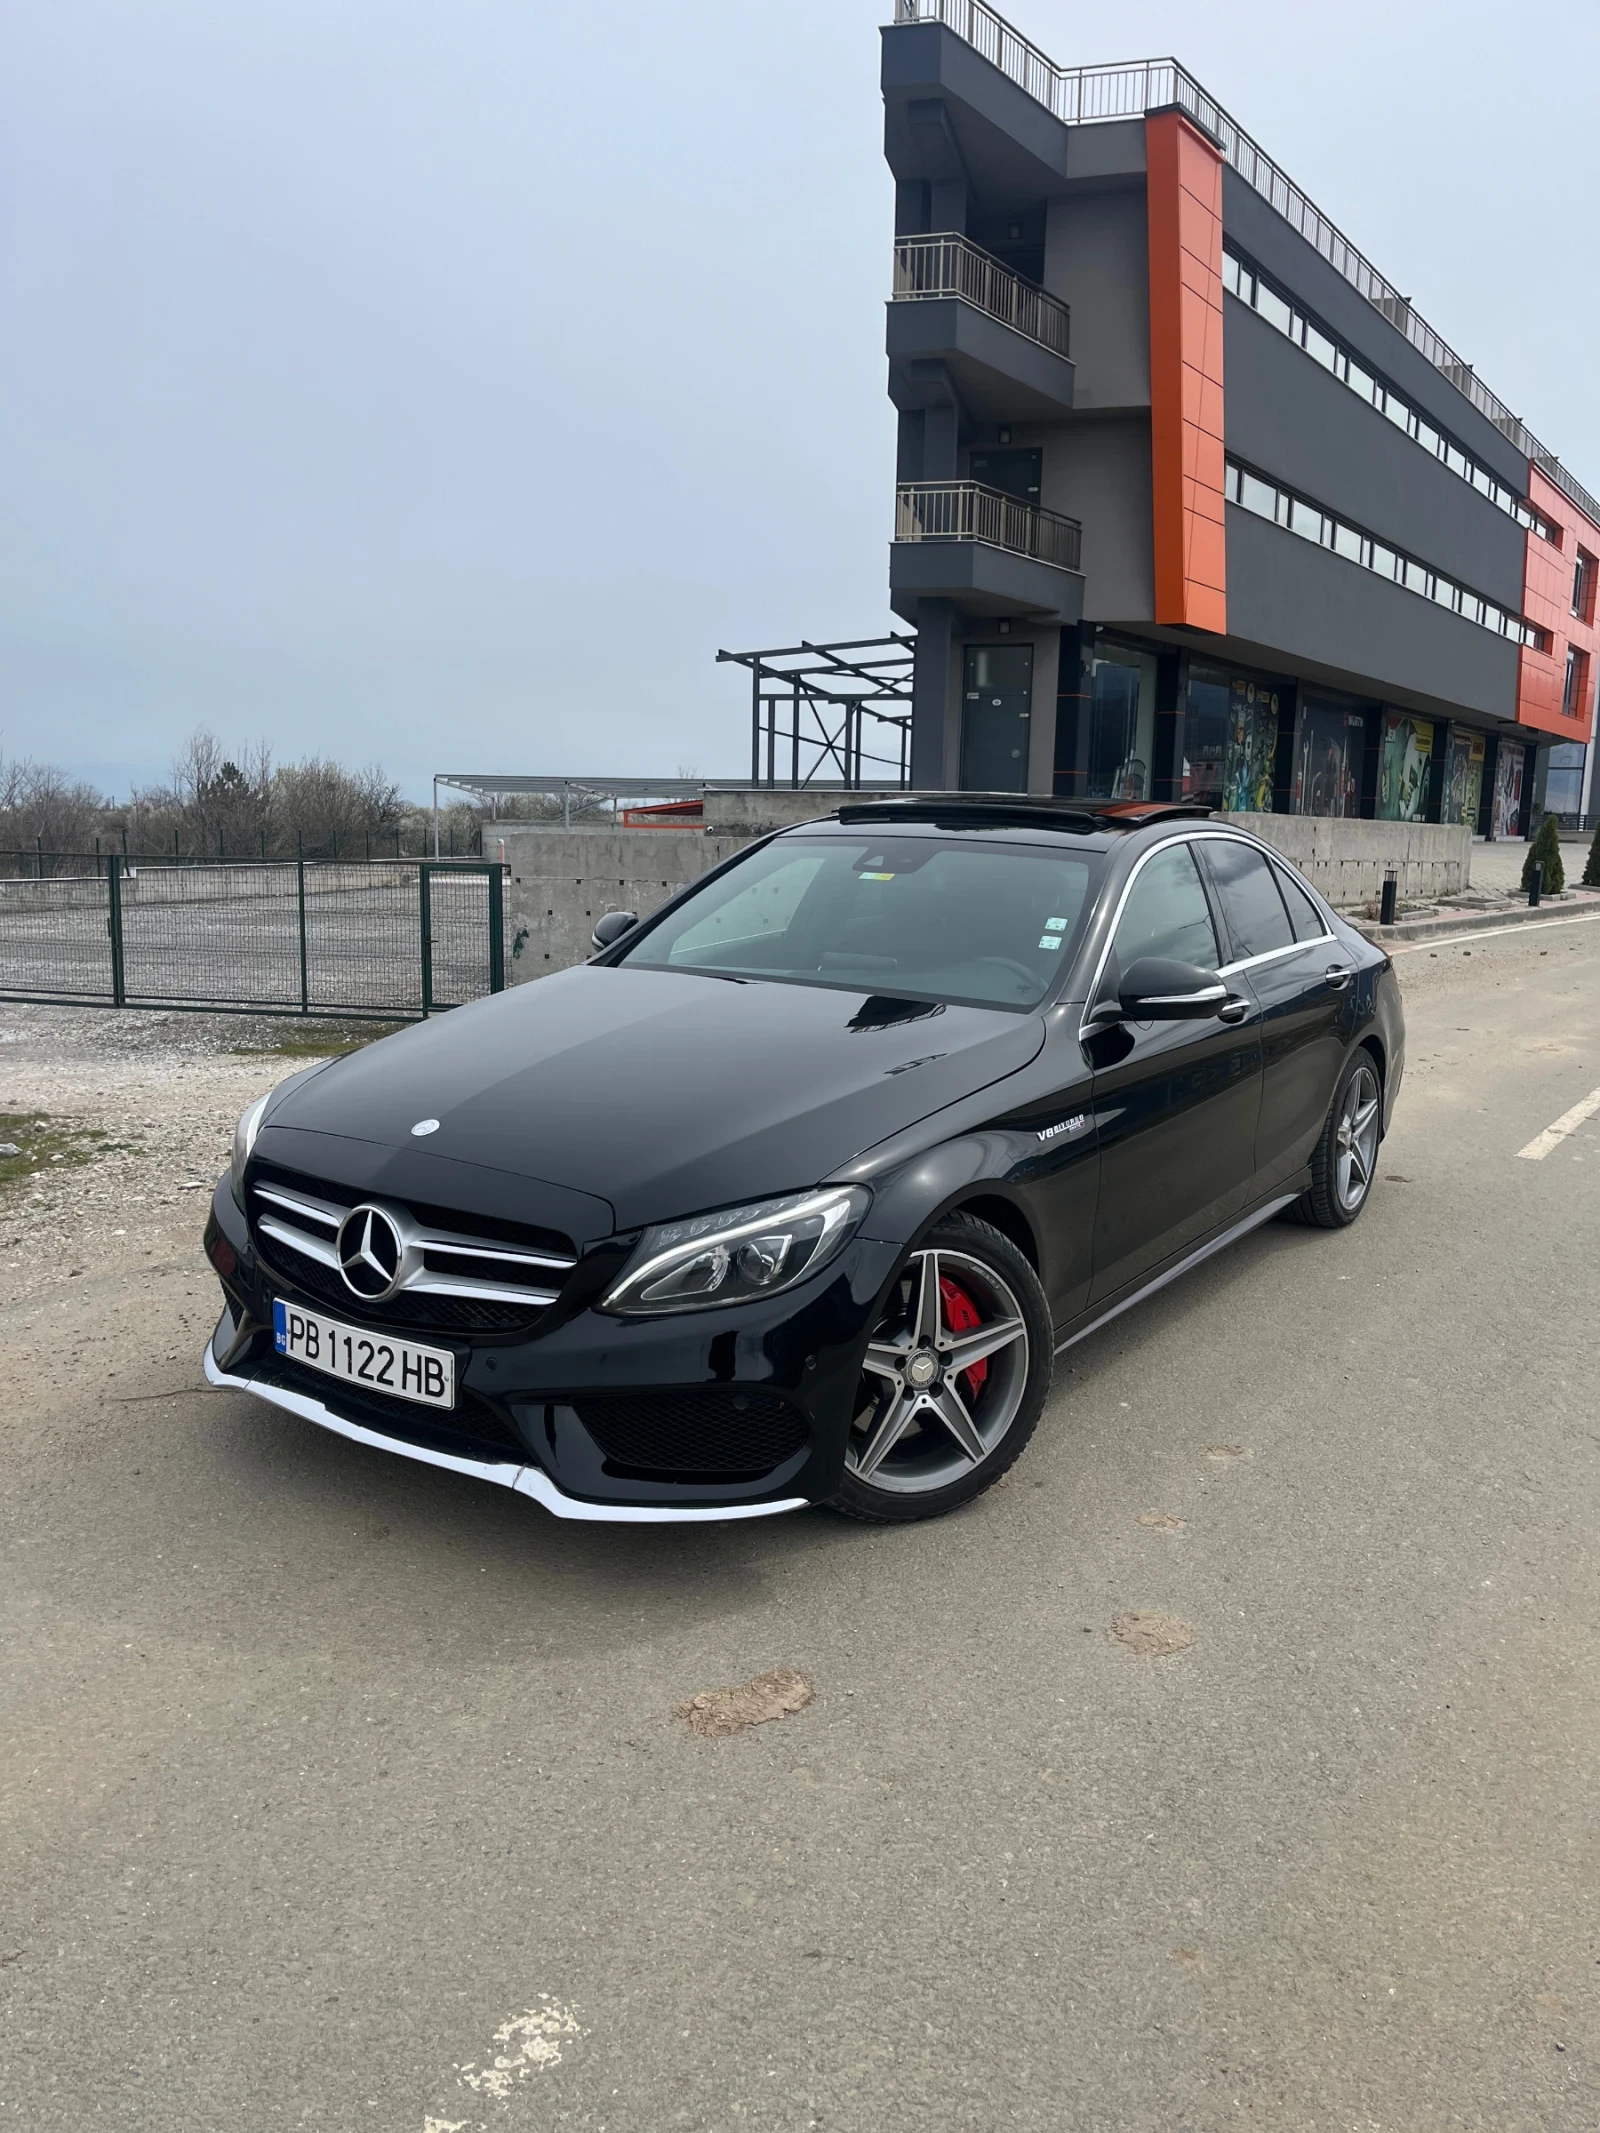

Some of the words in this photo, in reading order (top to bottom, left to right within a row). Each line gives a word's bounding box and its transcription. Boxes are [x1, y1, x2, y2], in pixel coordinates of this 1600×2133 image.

[1037, 1127, 1054, 1141] V8
[276, 1332, 286, 1346] BG
[289, 1313, 320, 1360] PB
[328, 1329, 395, 1387] 1122
[402, 1350, 445, 1398] HB
